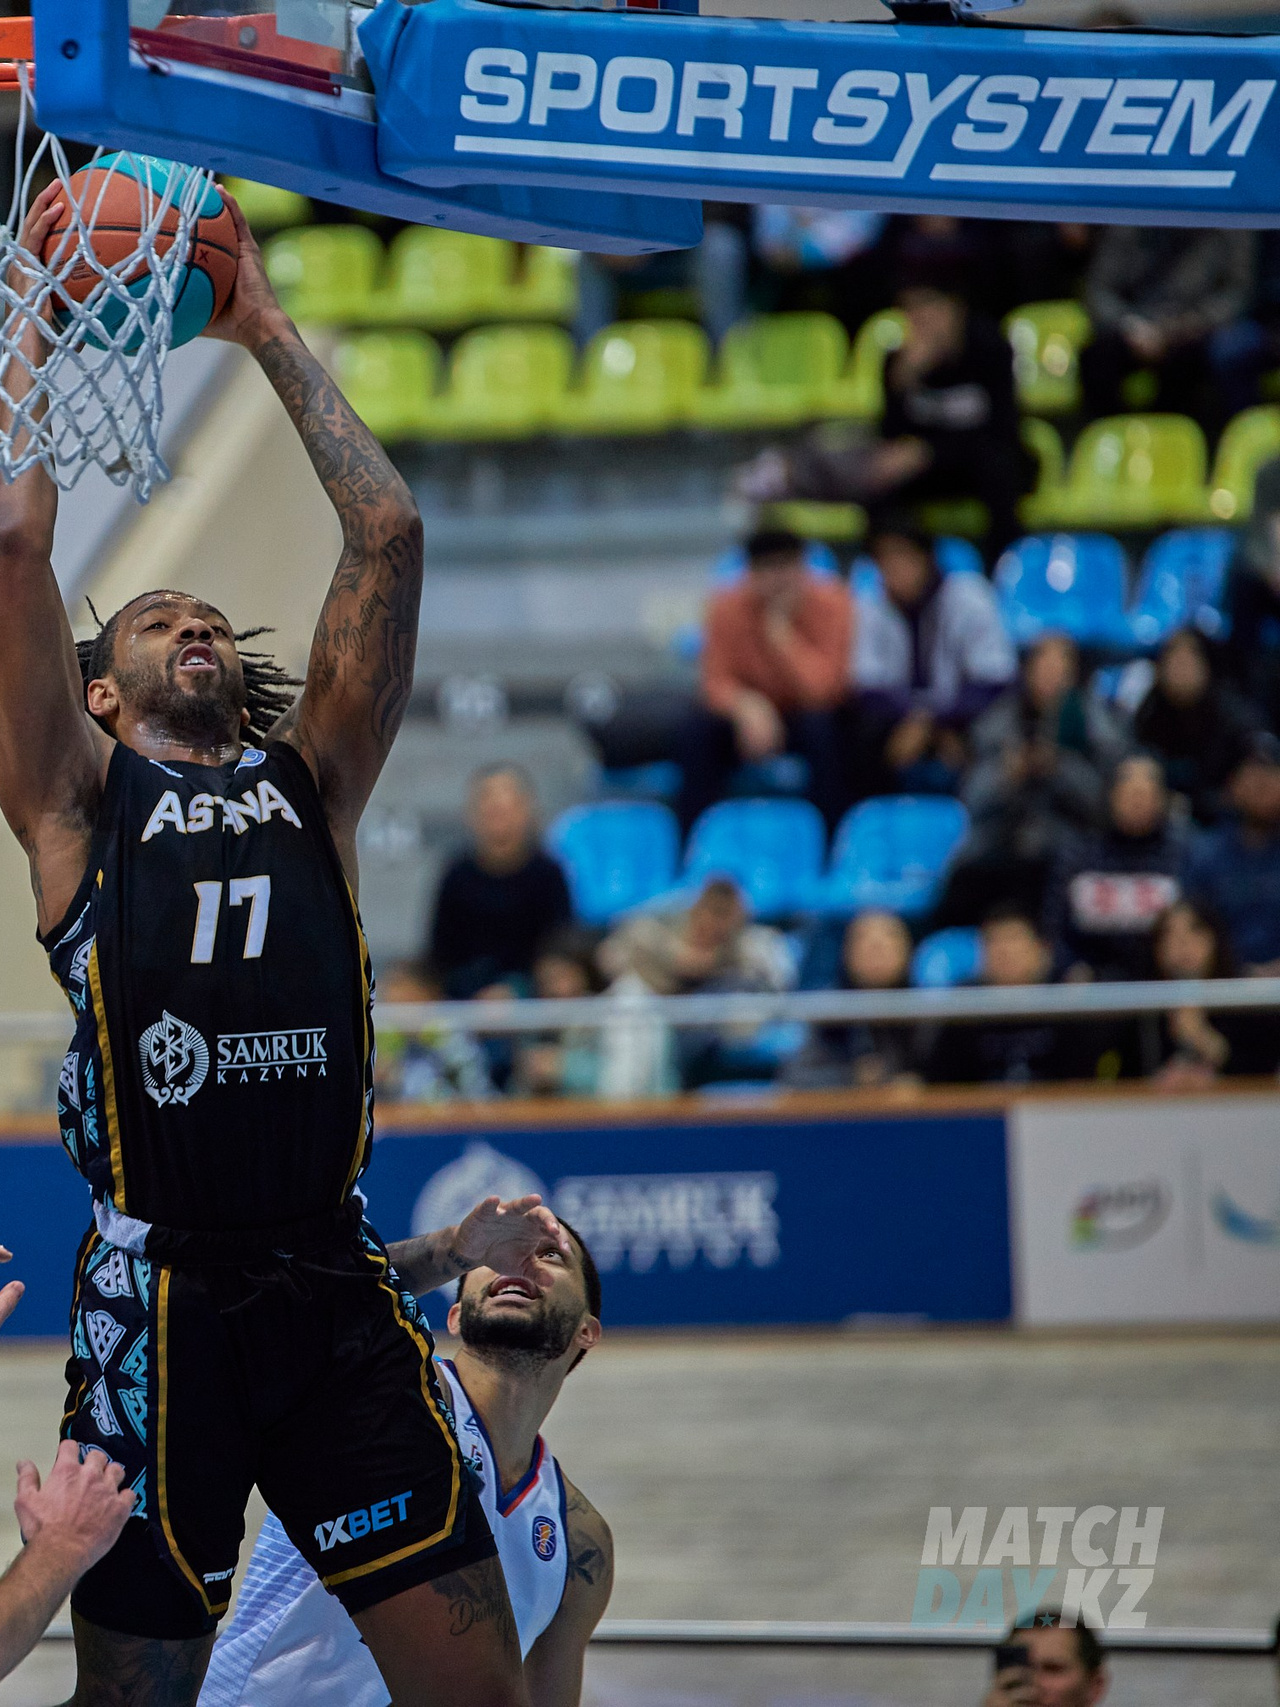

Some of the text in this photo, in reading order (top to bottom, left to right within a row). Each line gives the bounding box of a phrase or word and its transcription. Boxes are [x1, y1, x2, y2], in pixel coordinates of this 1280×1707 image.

[460, 47, 1277, 178] SPORTSYSTEM
[191, 875, 271, 964] 17
[217, 1032, 327, 1065] SAMRUK
[217, 1063, 327, 1084] KAZYNA
[314, 1490, 413, 1552] 1XBET
